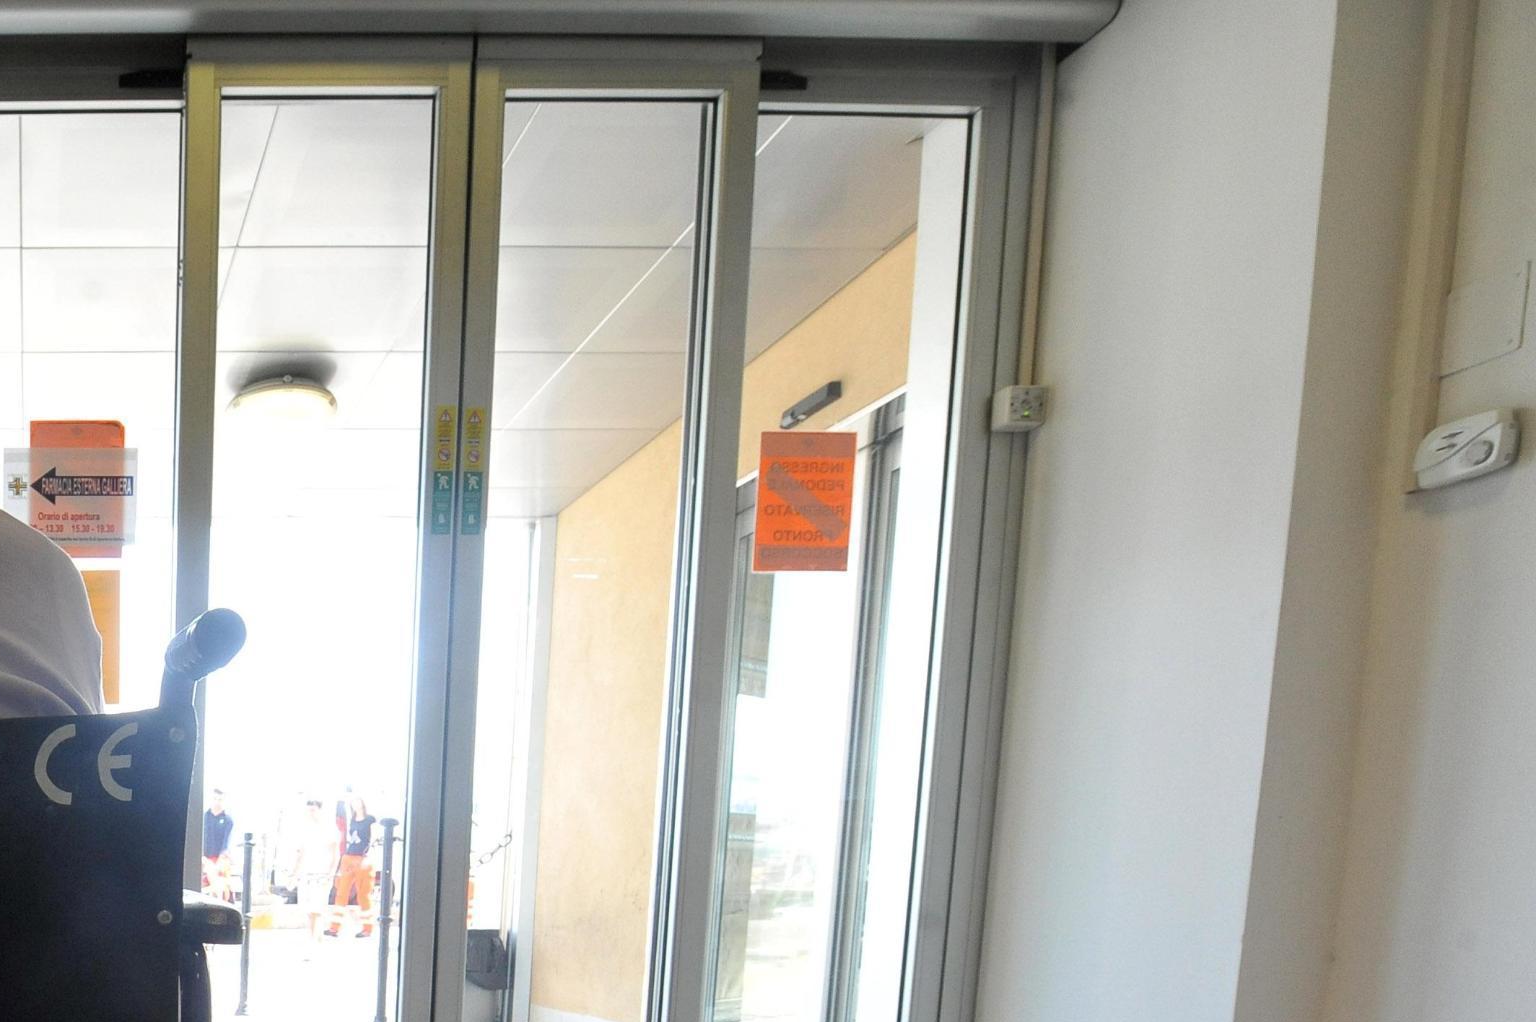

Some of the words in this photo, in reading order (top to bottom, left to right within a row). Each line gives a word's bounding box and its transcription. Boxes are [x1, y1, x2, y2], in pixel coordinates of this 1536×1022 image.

[41, 478, 72, 495] FARMACIA
[73, 478, 101, 495] ESTERNA
[102, 478, 132, 495] GALLIERA
[38, 512, 60, 520] Orario
[61, 512, 69, 520] di
[70, 513, 100, 522] apertura
[34, 722, 138, 805] CE
